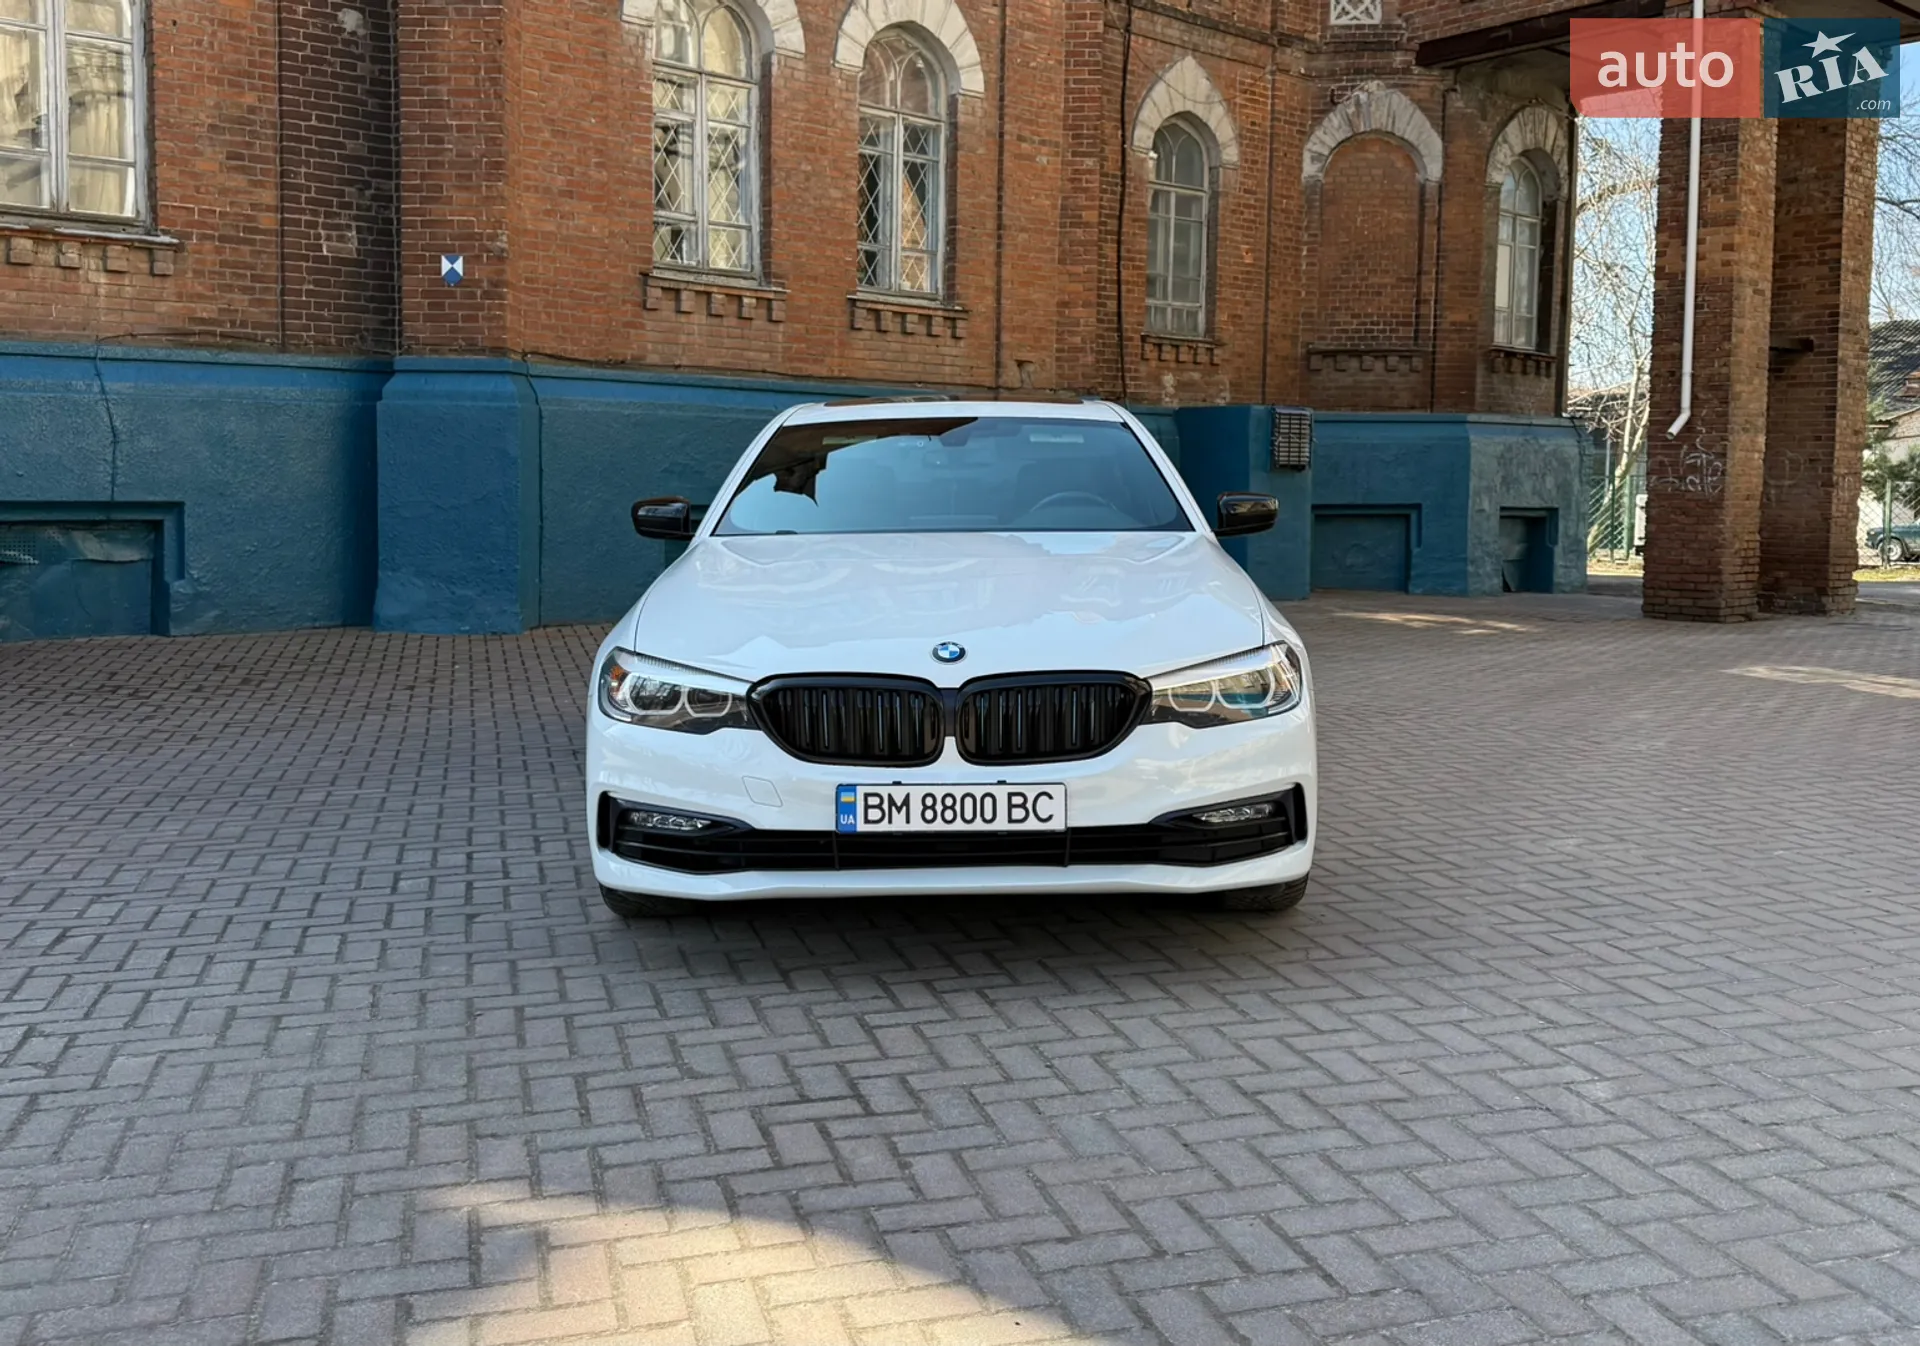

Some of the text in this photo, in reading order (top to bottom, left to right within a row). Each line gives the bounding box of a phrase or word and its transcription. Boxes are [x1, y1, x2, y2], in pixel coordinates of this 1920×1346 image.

[863, 790, 1054, 825] BM 8800 BC
[840, 814, 856, 825] UA
